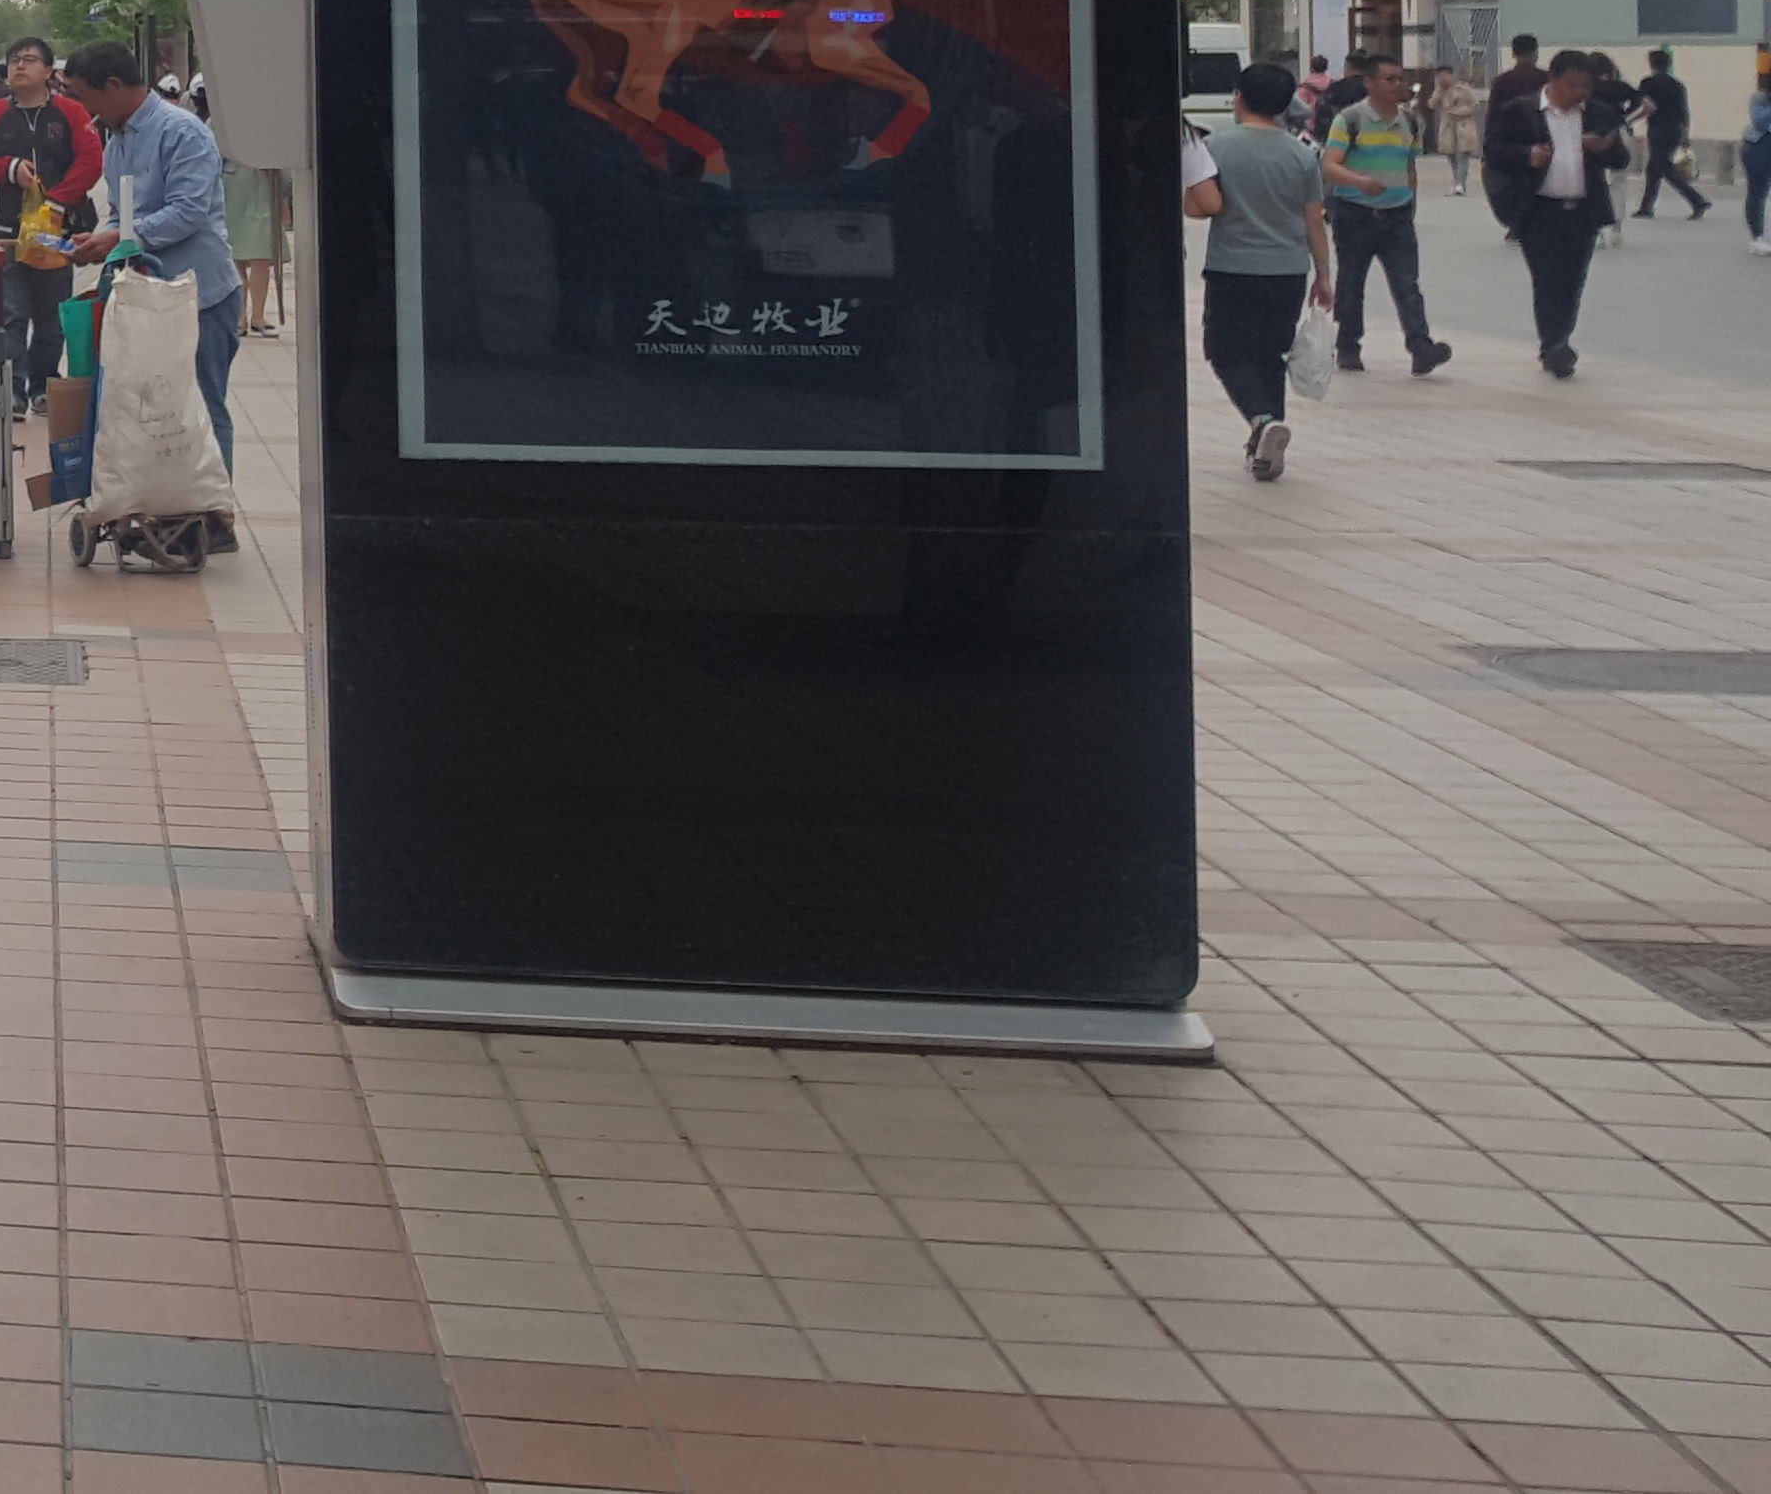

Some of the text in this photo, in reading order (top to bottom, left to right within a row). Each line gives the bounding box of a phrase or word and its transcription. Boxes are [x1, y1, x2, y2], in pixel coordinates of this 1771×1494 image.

[645, 298, 850, 338] 天边牧业
[710, 343, 764, 357] ANIMAL
[770, 344, 863, 358] HUSBANDRY
